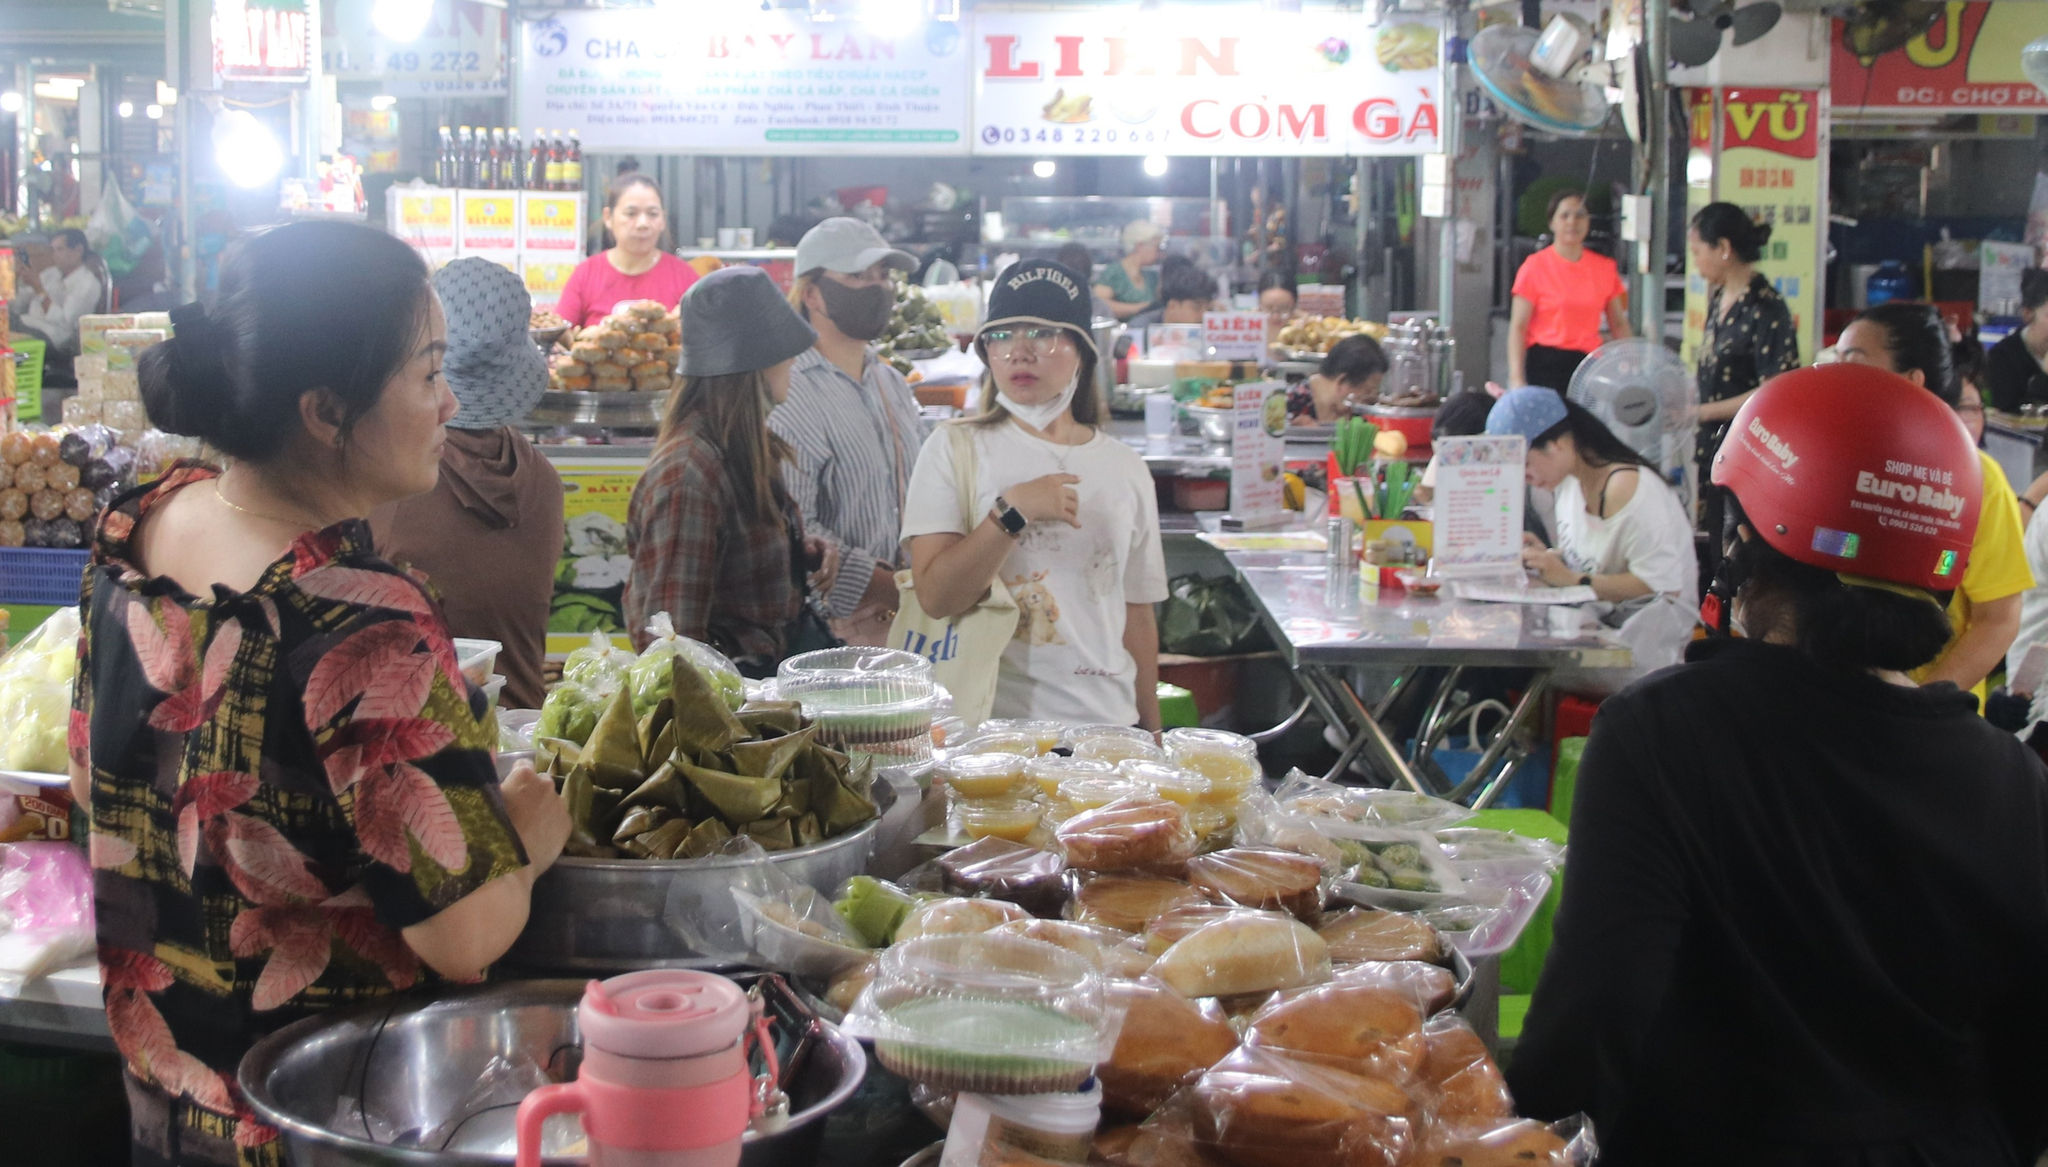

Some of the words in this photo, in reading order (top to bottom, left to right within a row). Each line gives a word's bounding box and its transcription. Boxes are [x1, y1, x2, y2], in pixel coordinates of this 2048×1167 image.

[809, 32, 895, 60] LAN
[430, 51, 480, 71] 272
[1951, 86, 2010, 105] CHỢ
[1180, 95, 1326, 140] CƠM
[1352, 87, 1439, 141] GÀ
[1726, 91, 1809, 142] VŨ
[1004, 128, 1063, 143] 0348
[1074, 128, 1117, 143] 220
[1207, 316, 1262, 331] LIÊN
[1748, 415, 1770, 444] Euro
[1766, 434, 1799, 469] Baby
[1885, 460, 1912, 477] SHOP
[1913, 465, 1928, 482] MẸ
[1929, 468, 1941, 483] VÀ
[1856, 470, 1916, 502] Euro
[1917, 484, 1965, 519] Baby
[24, 796, 46, 812] 200
